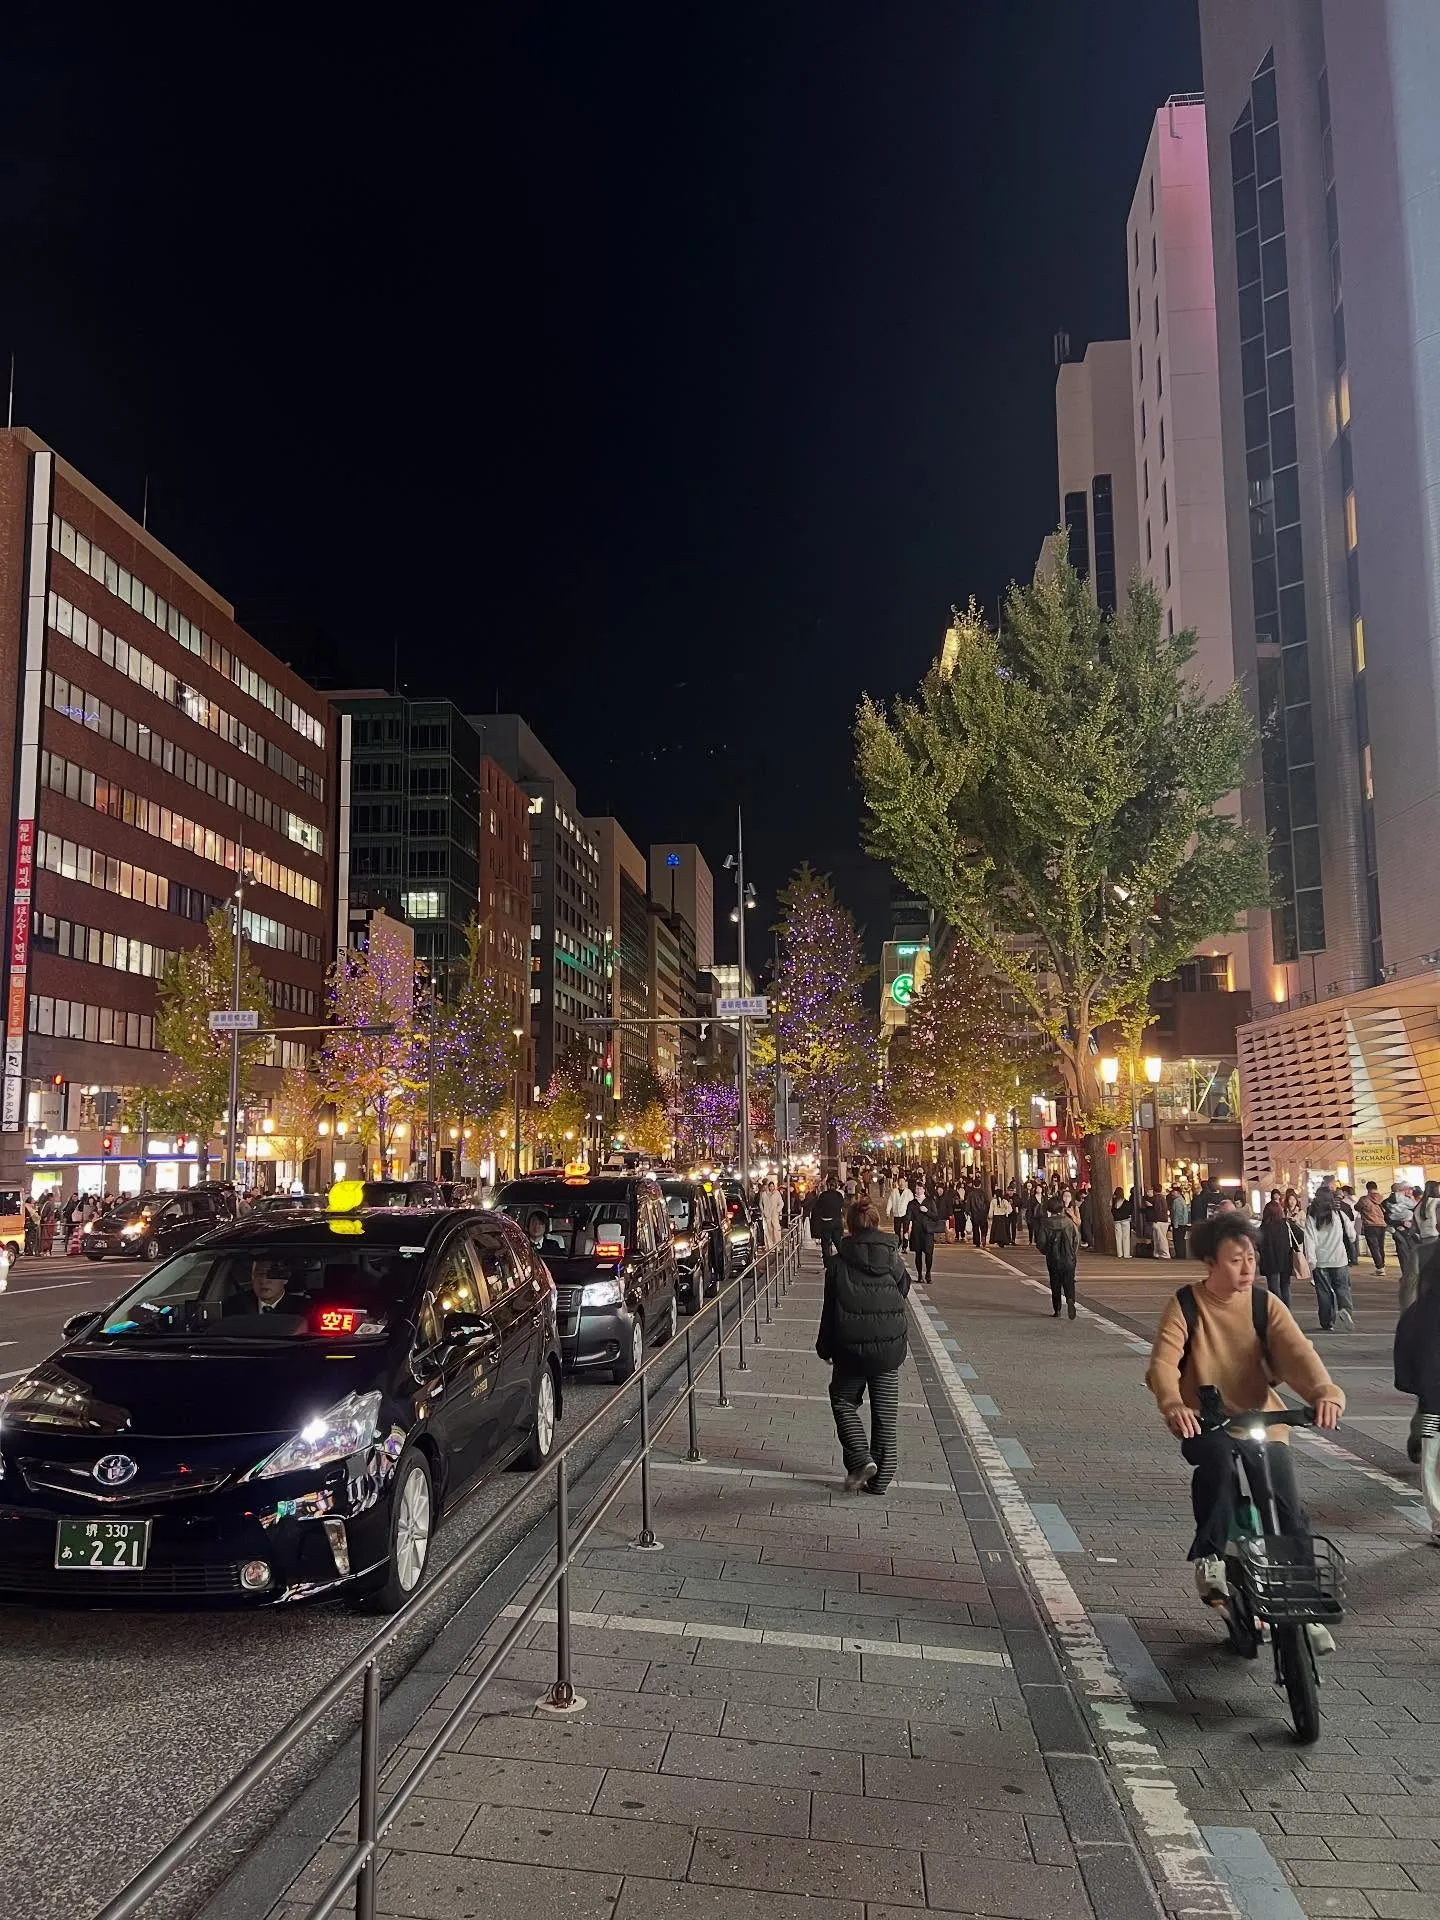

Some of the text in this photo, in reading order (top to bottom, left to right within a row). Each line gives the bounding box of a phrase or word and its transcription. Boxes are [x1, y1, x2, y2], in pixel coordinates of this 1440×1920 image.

[16, 906, 27, 941] ほんやく
[7, 1068, 15, 1099] GNZA
[86, 1523, 129, 1537] 堺 330
[62, 1546, 73, 1559] あ
